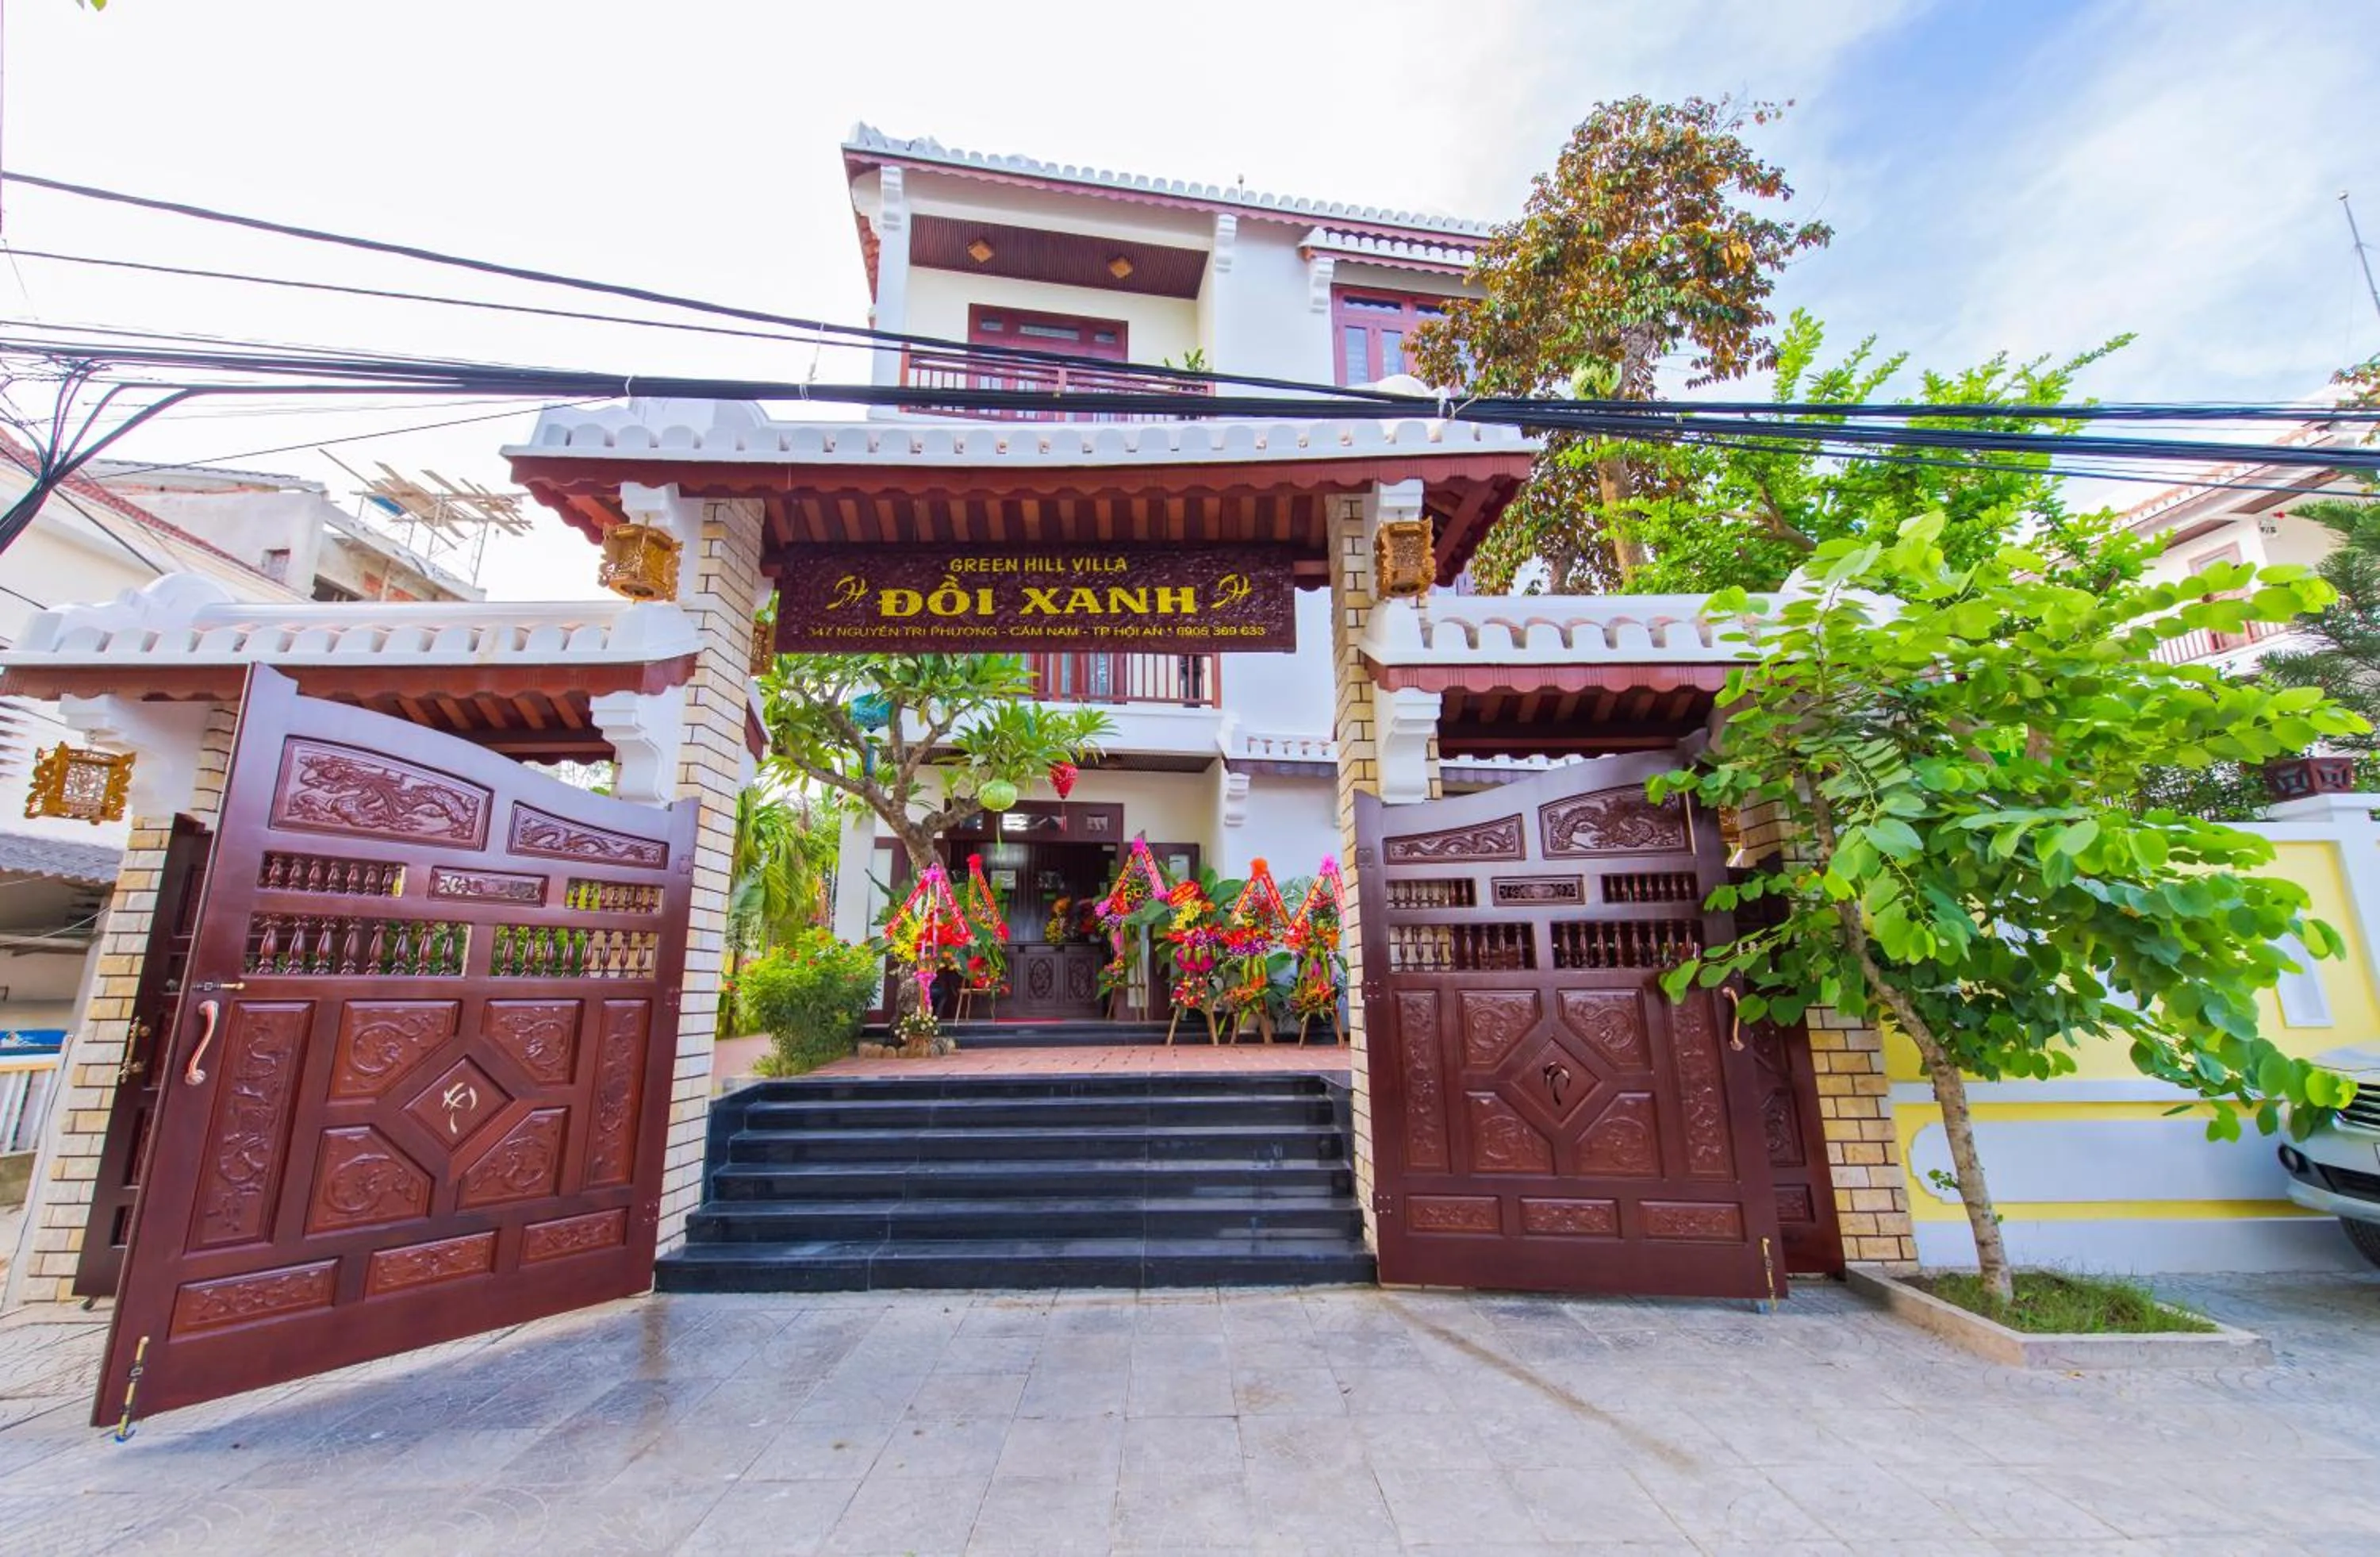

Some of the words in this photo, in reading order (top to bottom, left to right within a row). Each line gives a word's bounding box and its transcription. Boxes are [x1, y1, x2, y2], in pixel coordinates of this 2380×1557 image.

[950, 557, 1018, 572] GREEN
[1024, 557, 1066, 572] HILL
[1072, 556, 1127, 572] VILLA
[877, 574, 996, 617] ĐỒI
[1019, 586, 1198, 616] XANH
[1046, 625, 1079, 636] NAM
[1092, 625, 1111, 636] TP
[1142, 626, 1162, 636] AN
